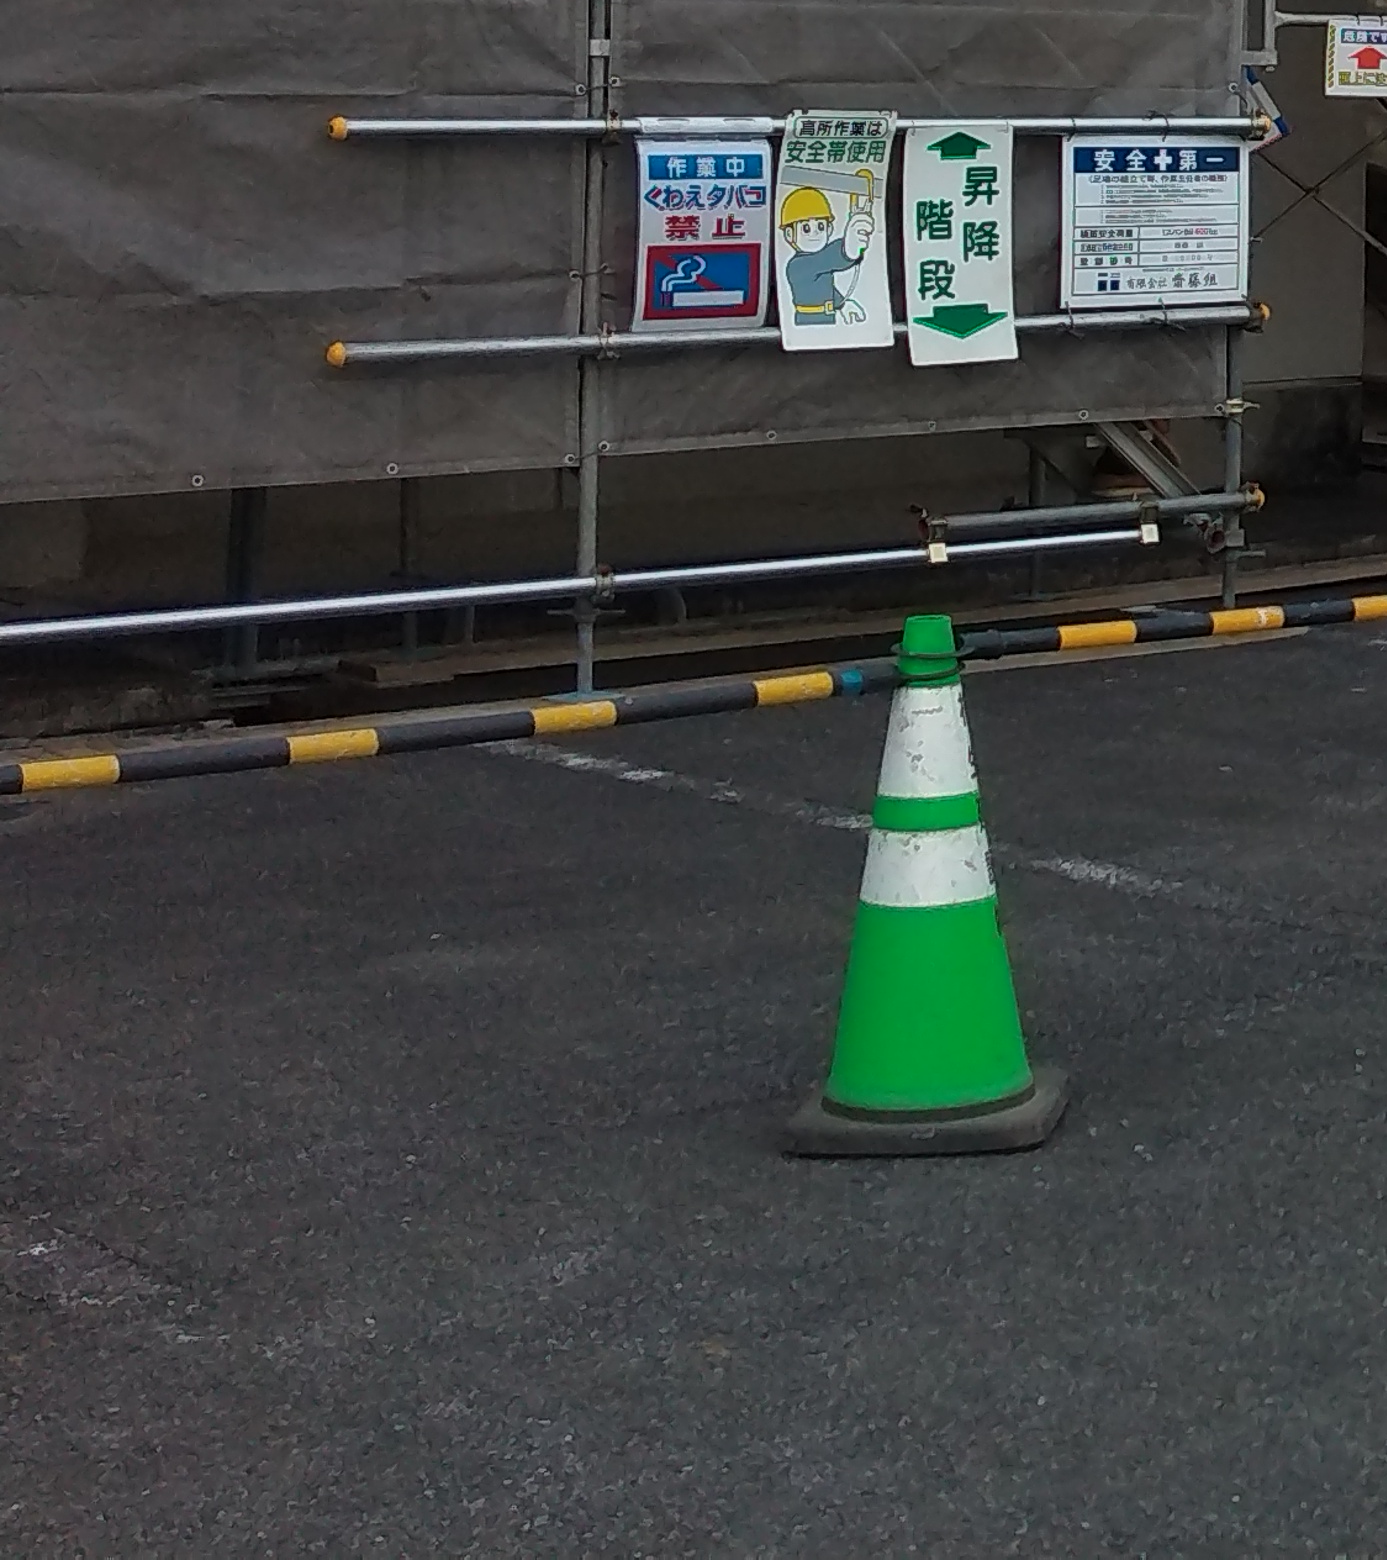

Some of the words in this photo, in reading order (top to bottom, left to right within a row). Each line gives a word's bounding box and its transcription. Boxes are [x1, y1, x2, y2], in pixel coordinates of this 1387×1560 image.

[800, 120, 882, 137] 高所作業は
[784, 140, 886, 163] 安全帯使用
[666, 156, 745, 178] 作業中
[643, 184, 767, 210] くわえタバコ
[664, 214, 746, 241] 禁止
[962, 166, 999, 263] 昇降
[916, 198, 955, 301] 階段
